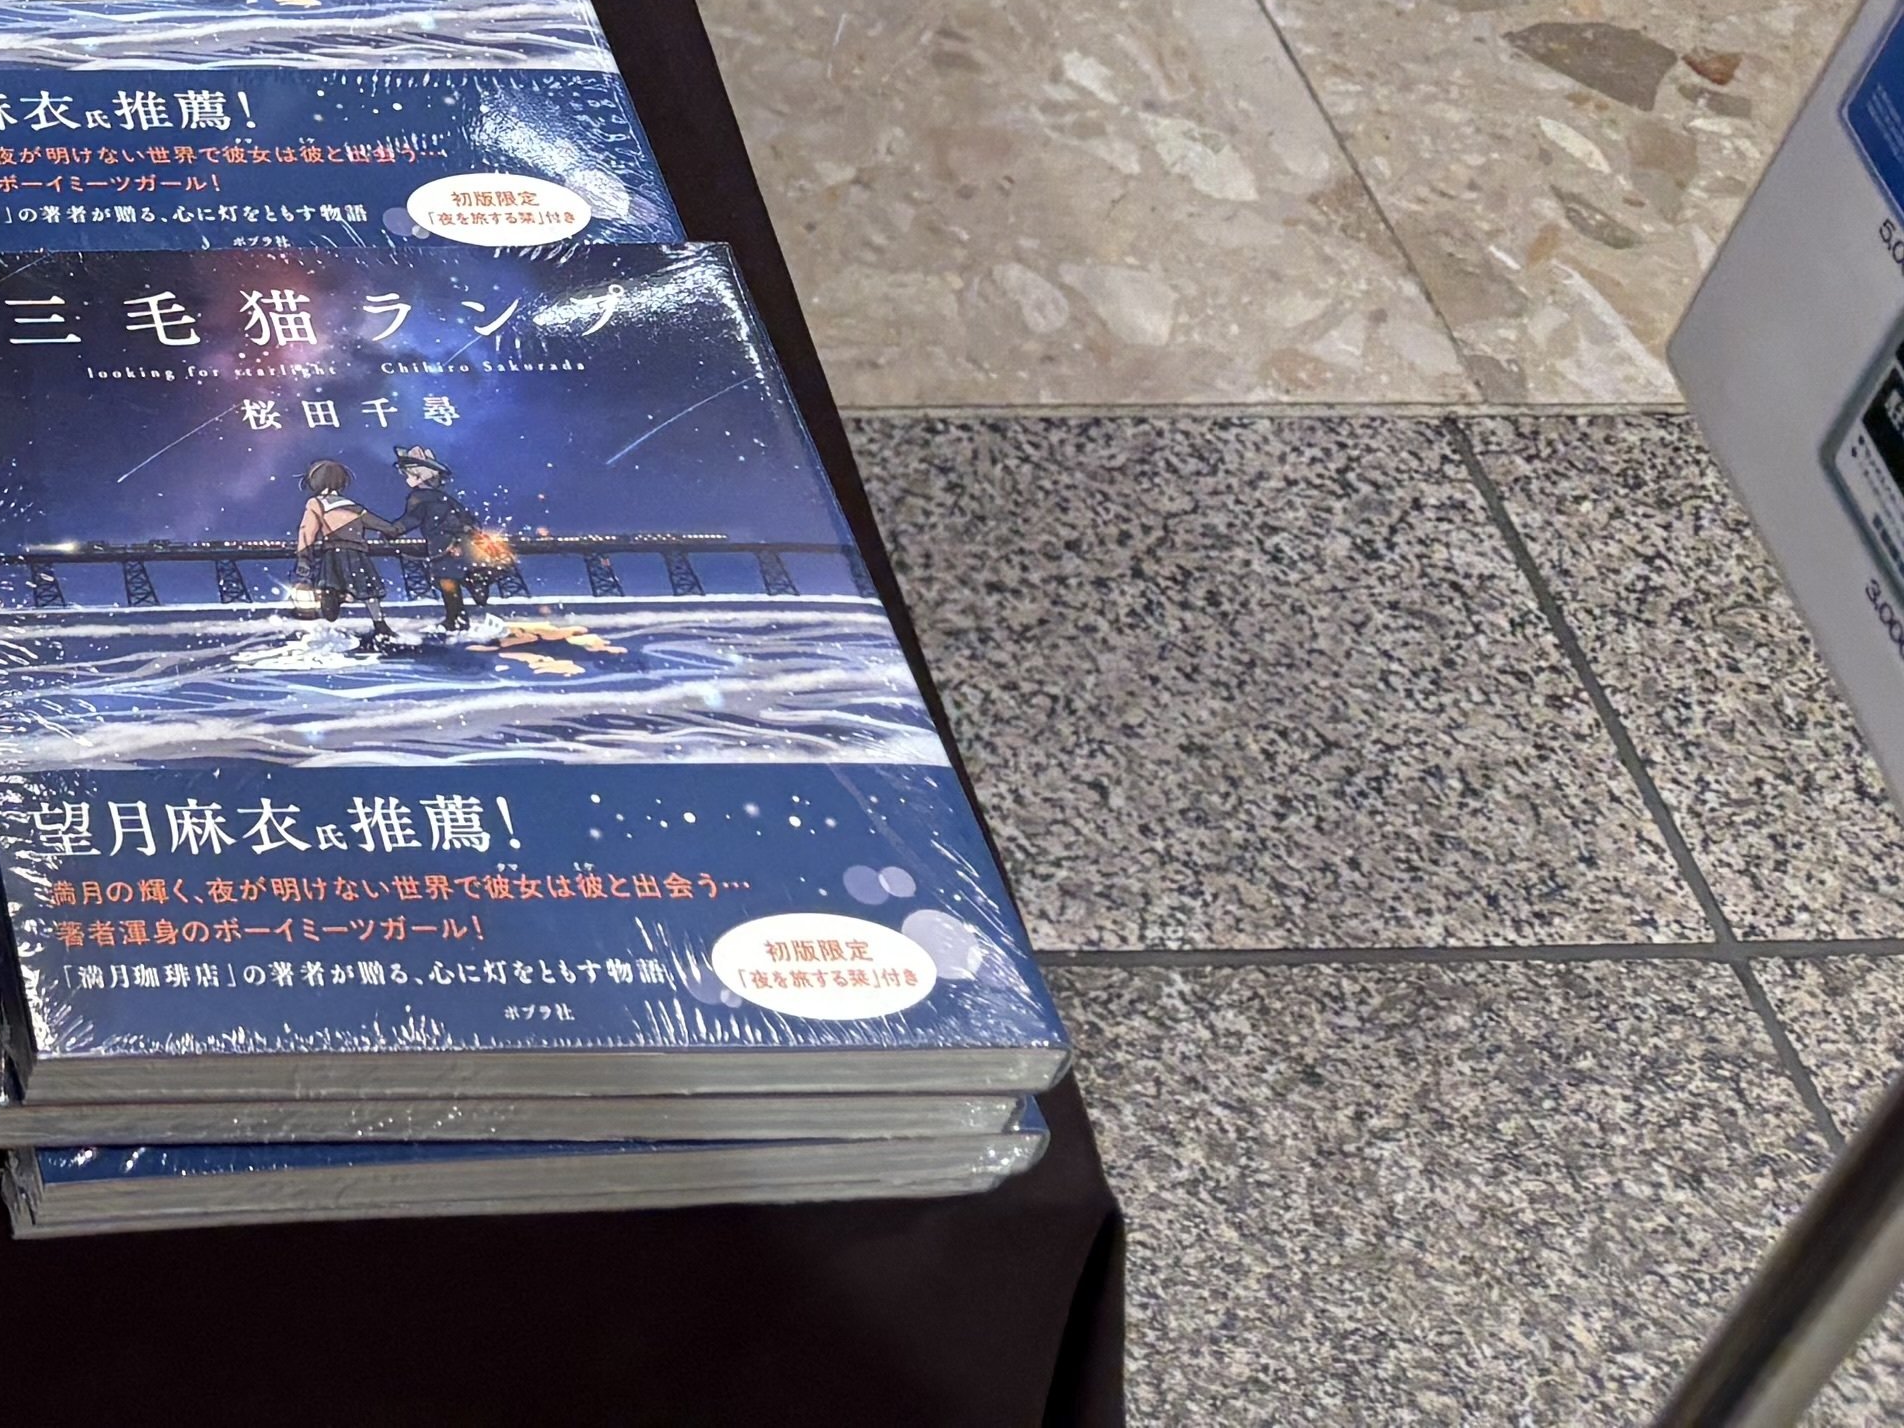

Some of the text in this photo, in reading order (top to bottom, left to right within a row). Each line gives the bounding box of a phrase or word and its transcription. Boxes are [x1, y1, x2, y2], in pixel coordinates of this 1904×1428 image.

[451, 190, 541, 208] 初版限定
[4, 281, 629, 350] 三毛猫ランプ
[86, 366, 180, 383] looking
[380, 359, 470, 376] Chihiro
[482, 358, 587, 376] Sakurada
[241, 395, 461, 432] 桜田千尋
[32, 795, 524, 862] 望月麻衣氏推薦!
[54, 916, 487, 944] 著者渾身のボーイミーツガール!
[764, 937, 875, 964] 初版限定
[502, 1002, 576, 1022] ポプラ社
